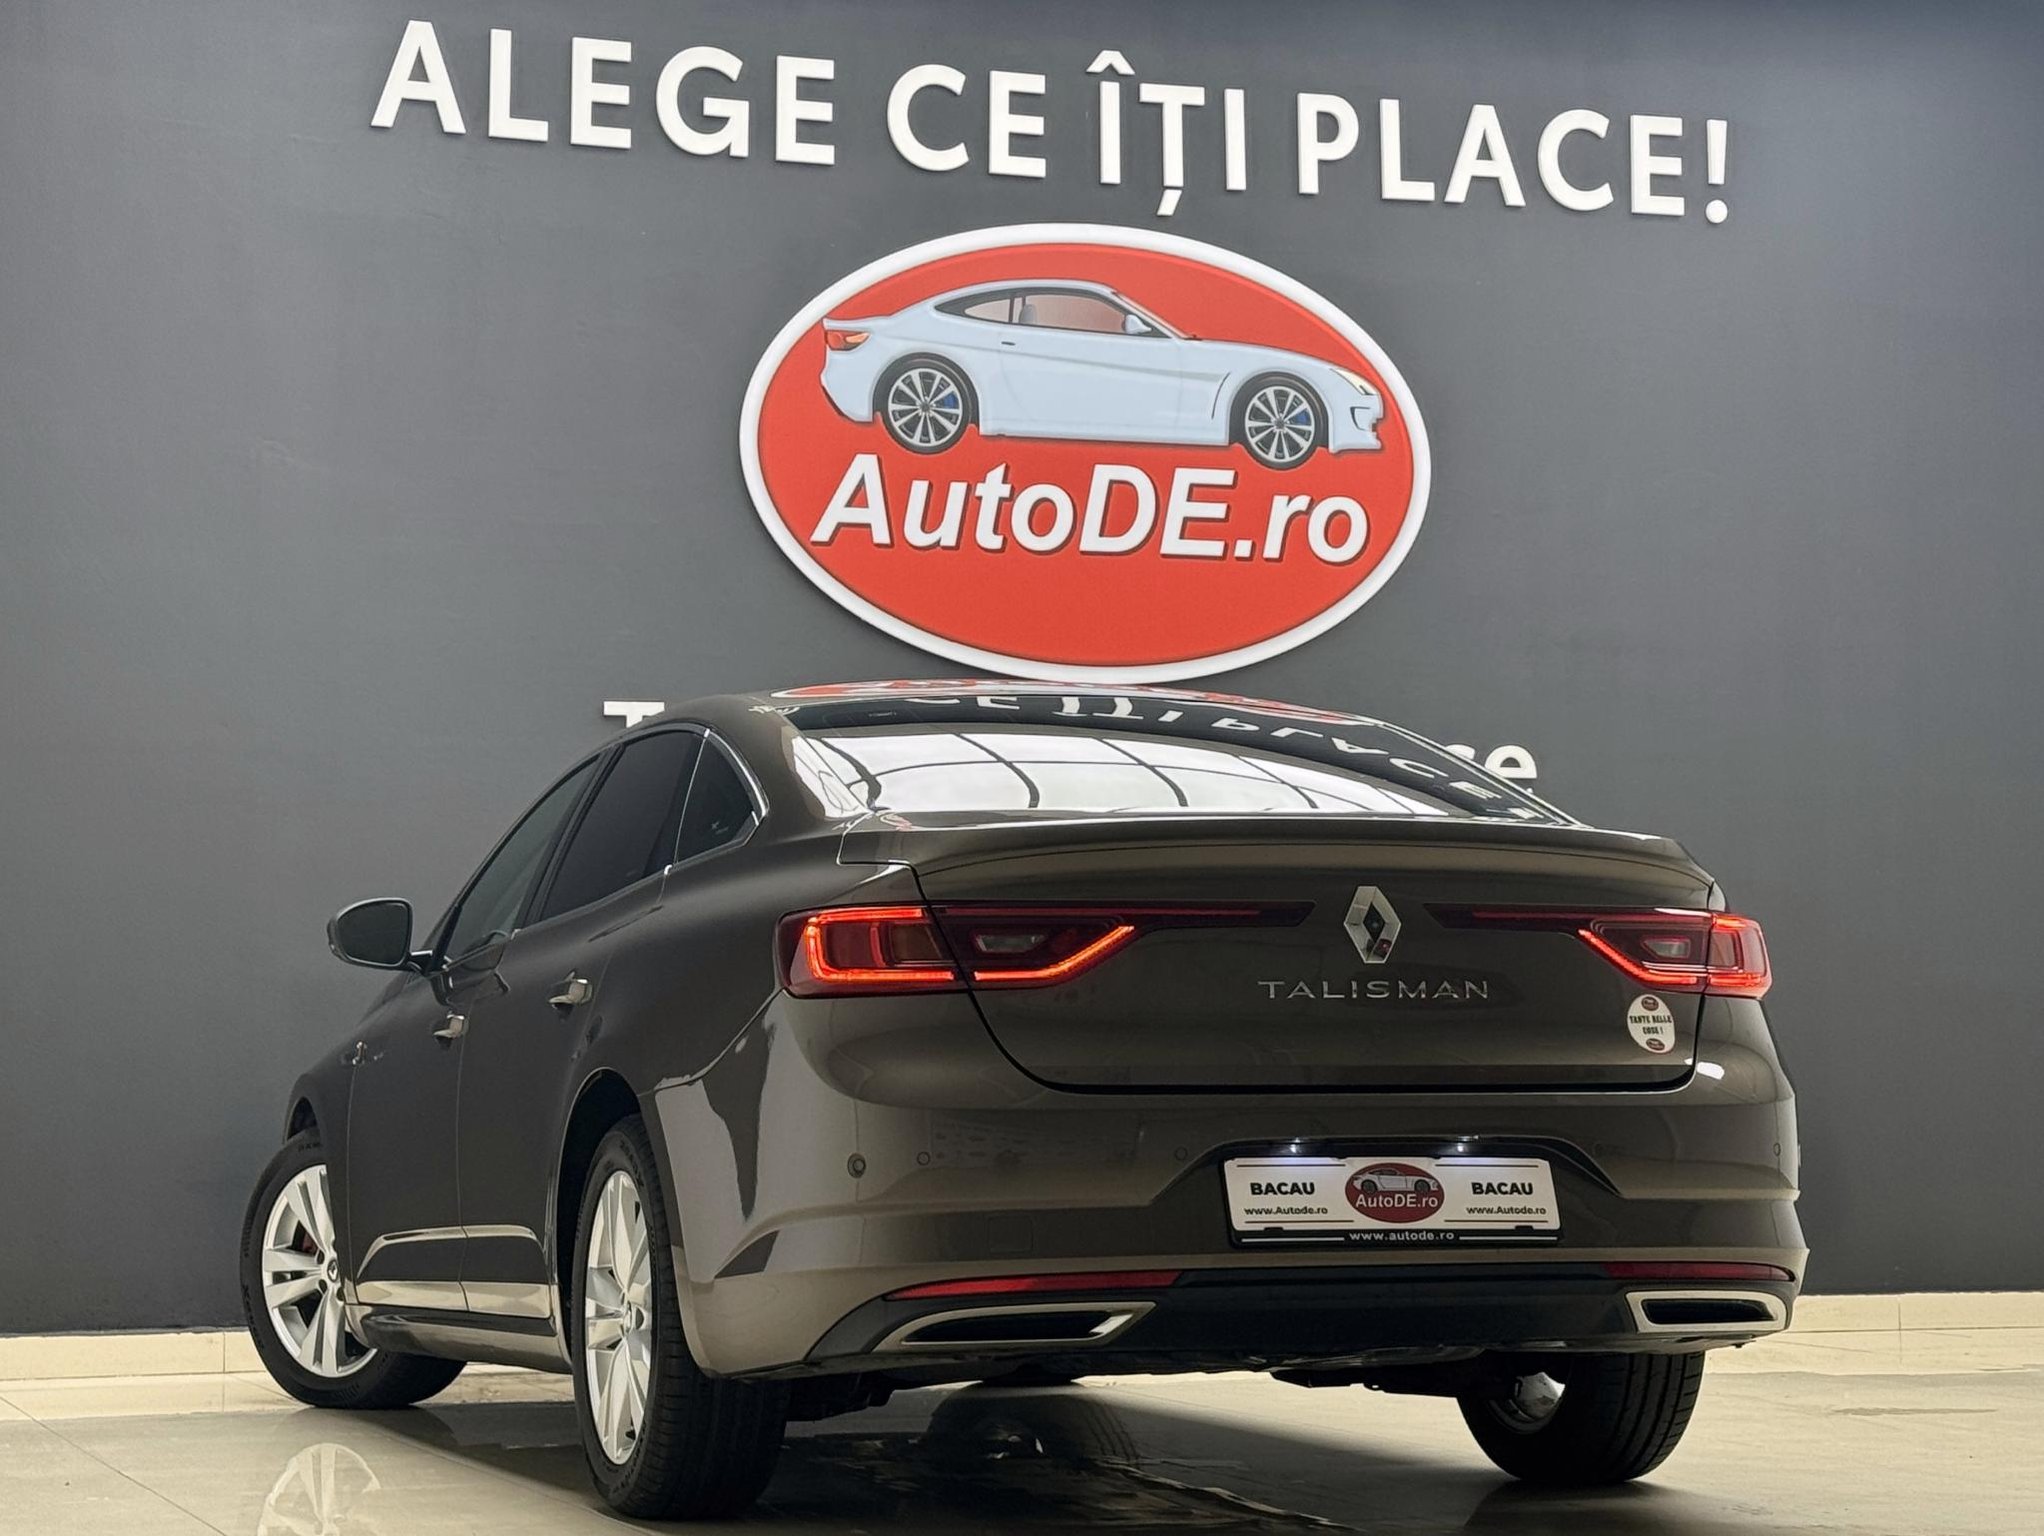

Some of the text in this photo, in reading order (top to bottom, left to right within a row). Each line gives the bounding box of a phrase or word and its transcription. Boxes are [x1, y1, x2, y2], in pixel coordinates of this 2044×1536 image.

[370, 19, 1729, 224] ALEGE CE ÎȚI PLACE!
[809, 453, 1371, 566] AutoDE.ro
[1257, 980, 1489, 1000] TALISMAN
[1250, 1182, 1316, 1196] BACAU
[1471, 1182, 1534, 1196] BACAU
[1355, 1193, 1439, 1210] AutoDE.ro
[1244, 1205, 1329, 1216] www.Autode.ro
[1466, 1205, 1547, 1216] www.Autode.ro
[1349, 1230, 1455, 1242] www.autode.ro
